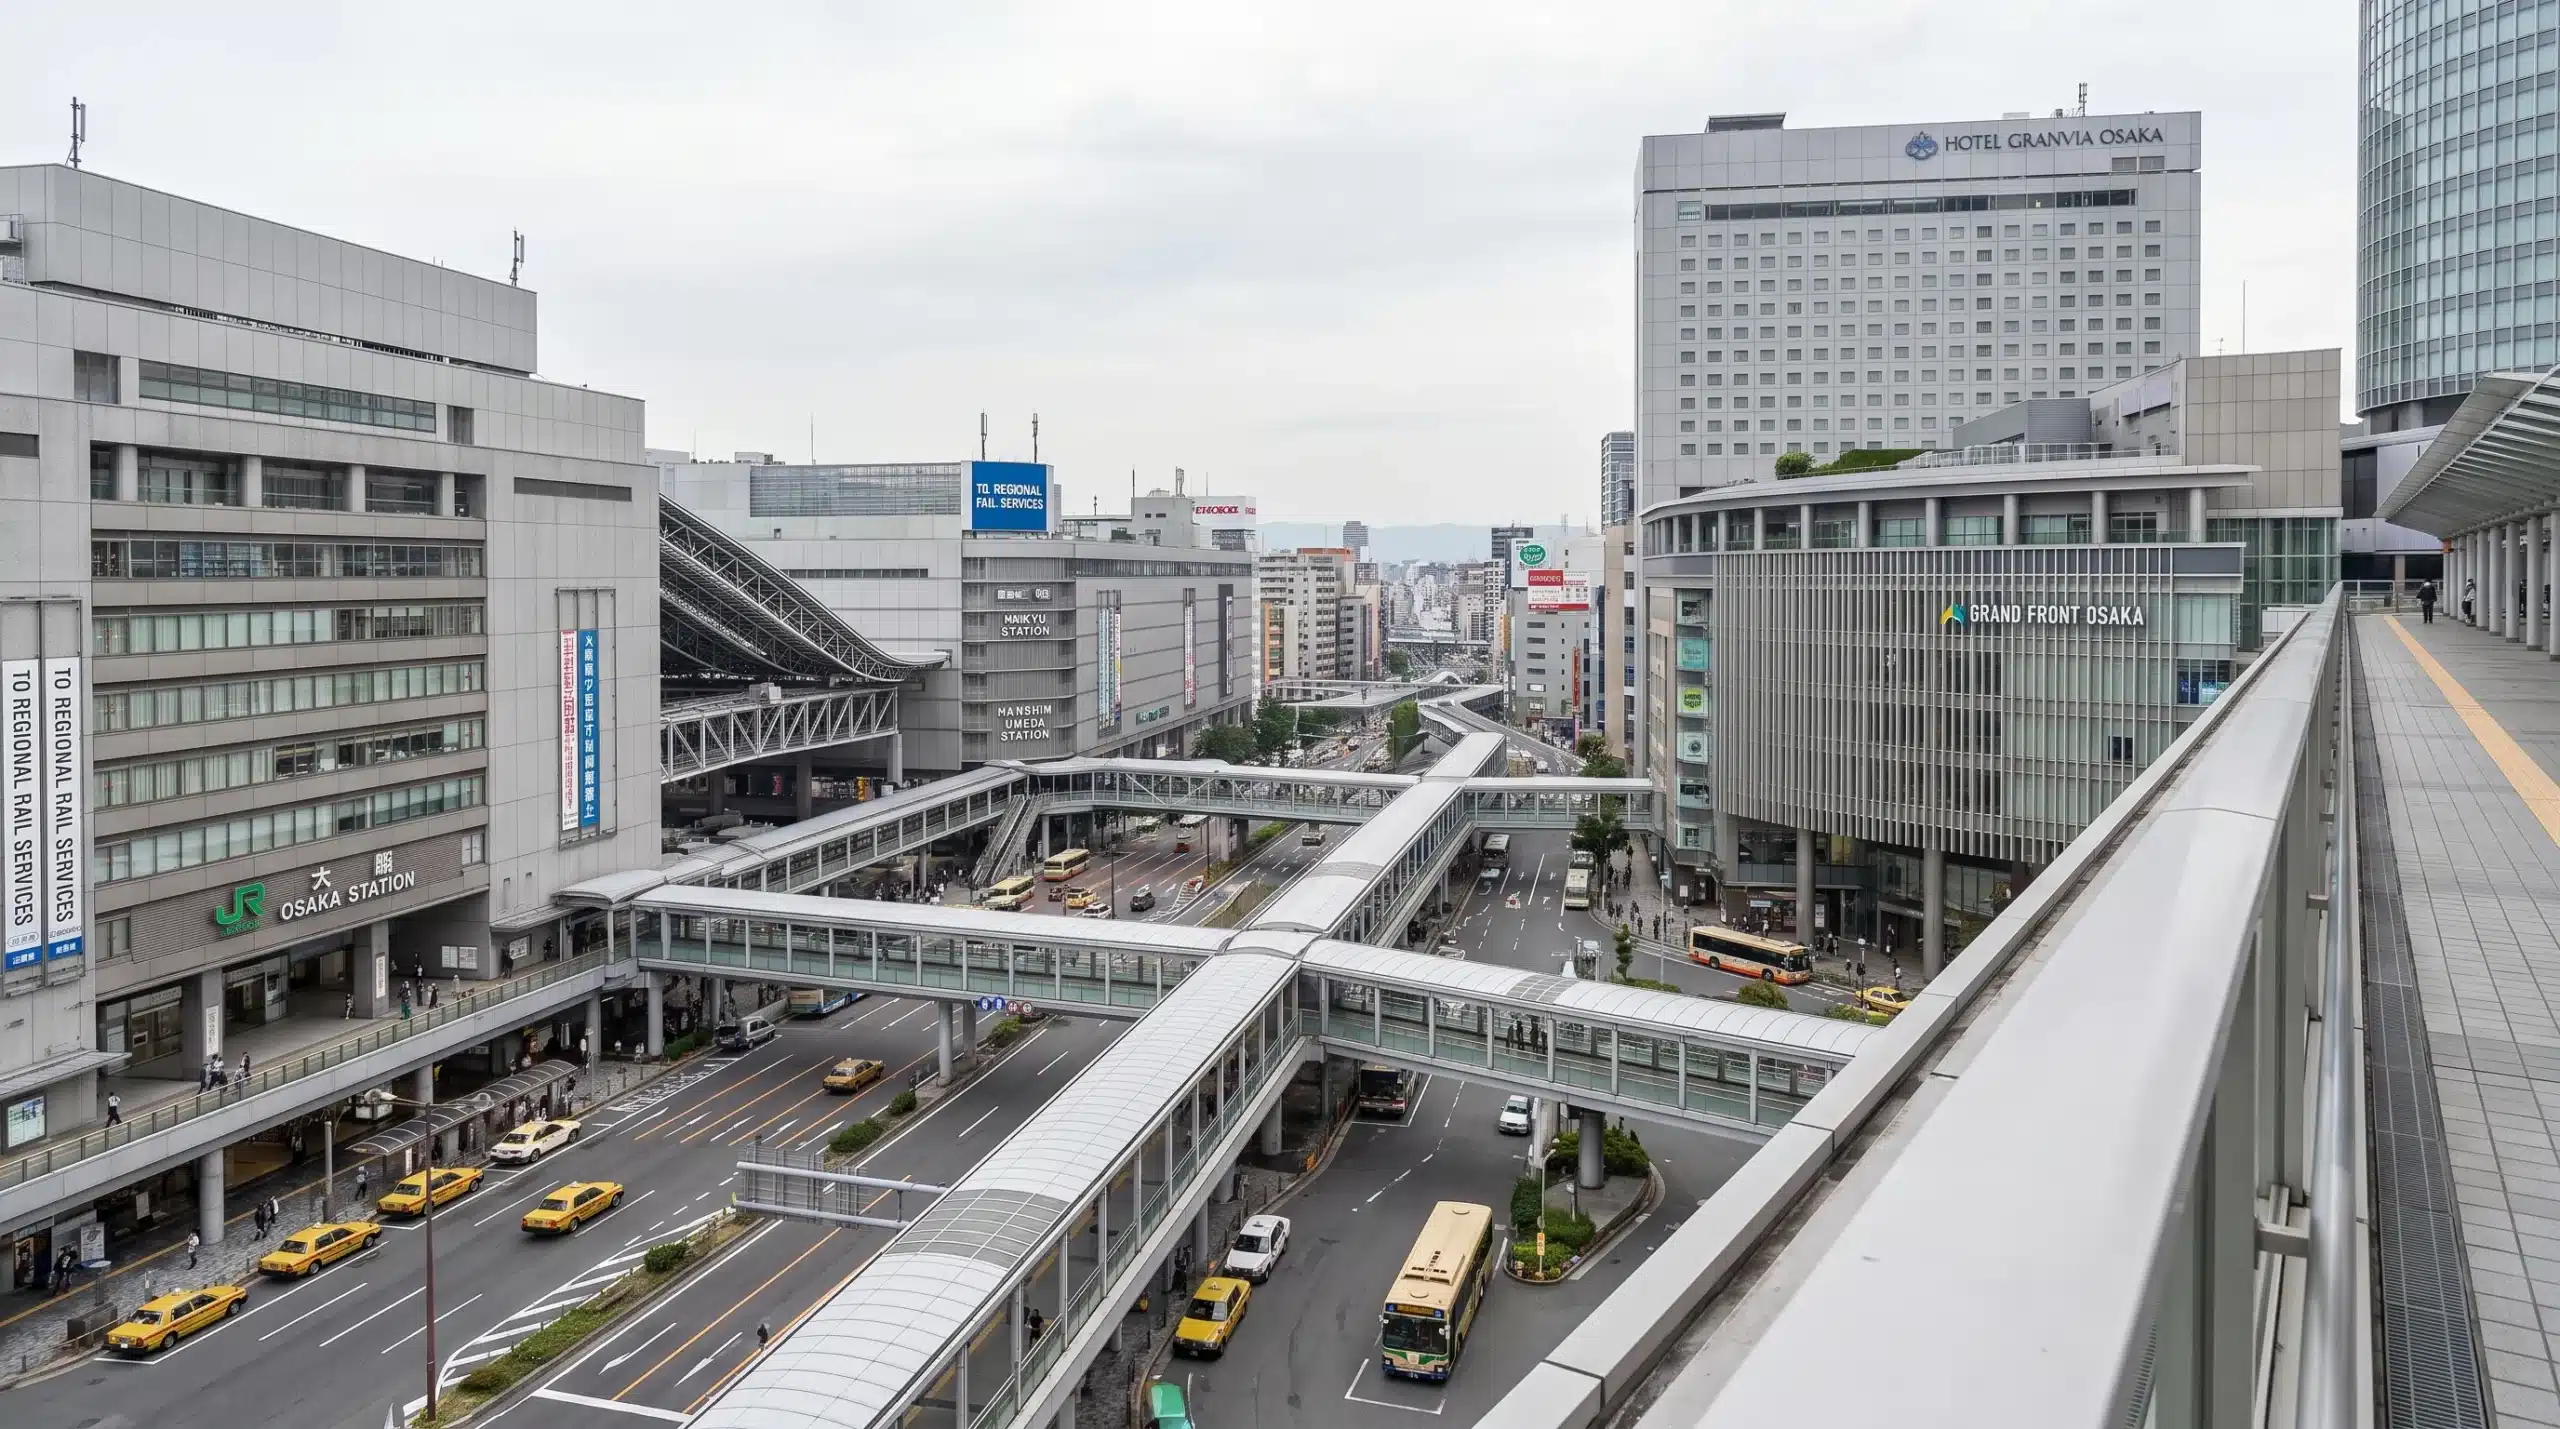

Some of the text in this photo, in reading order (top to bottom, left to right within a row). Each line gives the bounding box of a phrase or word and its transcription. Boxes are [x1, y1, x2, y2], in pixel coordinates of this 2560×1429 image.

[1945, 128, 2164, 151] HOTEL GRANVIA OSAKA
[993, 484, 1042, 496] REGIONAL
[1000, 498, 1044, 509] SERVICES
[1970, 604, 2144, 626] GRAND FRONT OSAKA
[1001, 626, 1050, 637] STATION
[12, 669, 31, 692] TO
[54, 668, 71, 690] TO
[997, 704, 1052, 717] MANSHIM
[1000, 729, 1049, 741] STATION
[1005, 718, 1045, 729] UMEDA
[12, 698, 32, 789] REGIONAL
[54, 697, 72, 788] REGIONAL
[14, 794, 32, 836] RAIL
[55, 793, 73, 834] RAIL
[14, 839, 33, 926] SERVICES
[56, 837, 74, 923] SERVICES
[215, 881, 266, 925] JR
[280, 870, 415, 921] OSAKA STATION
